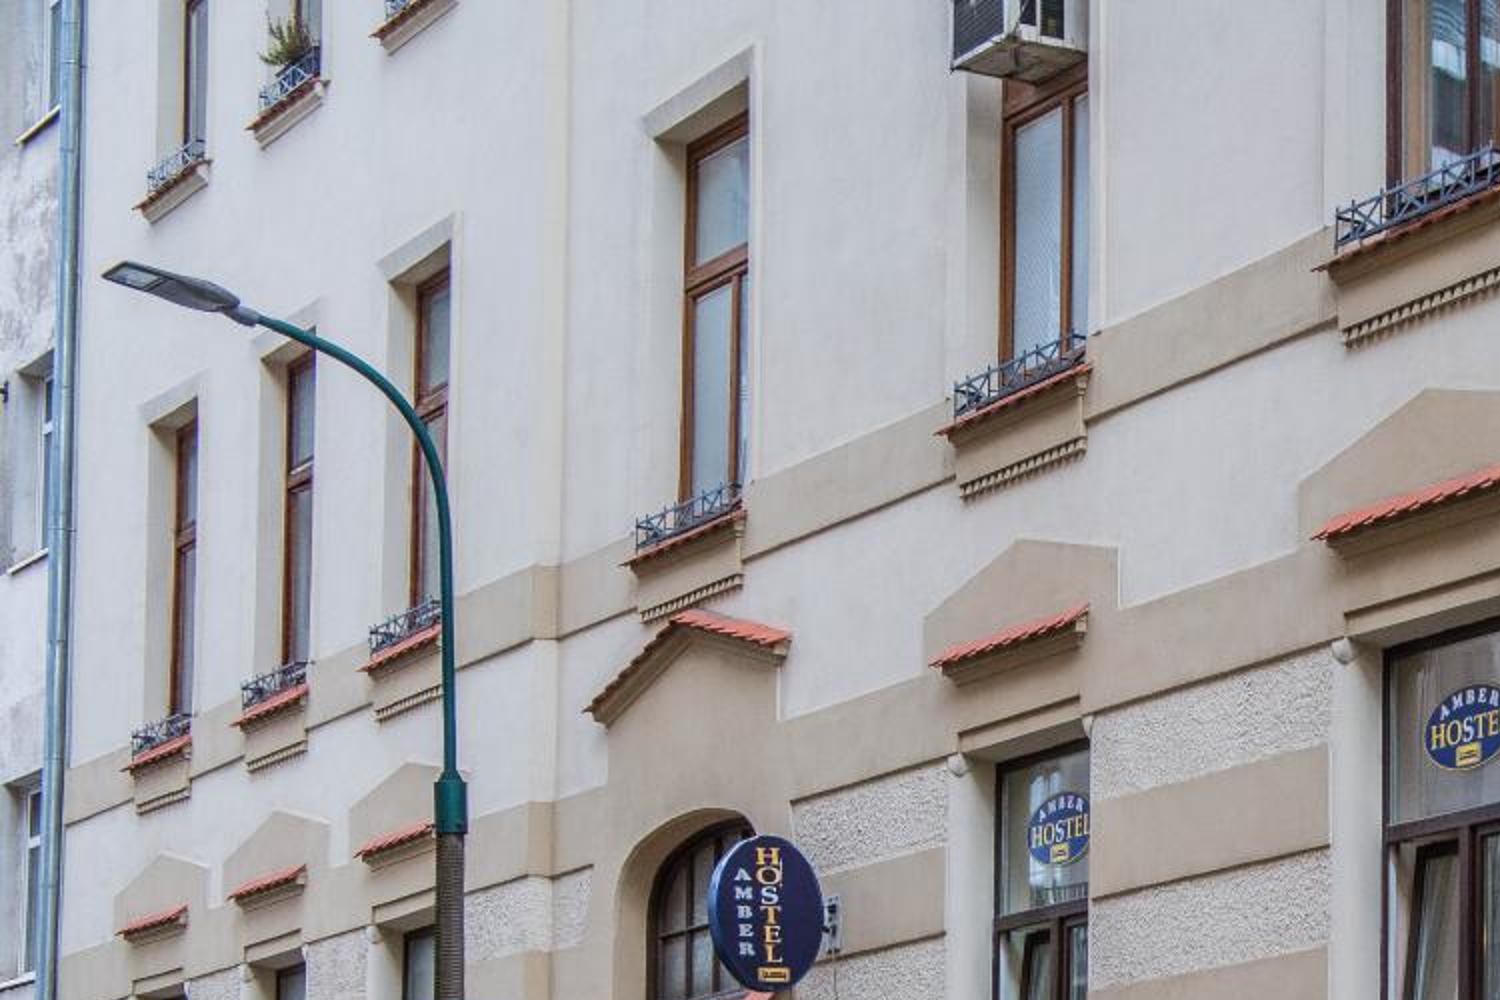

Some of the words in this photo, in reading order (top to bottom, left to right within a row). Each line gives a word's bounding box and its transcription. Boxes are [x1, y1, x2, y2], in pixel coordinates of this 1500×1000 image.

[1440, 687, 1500, 721] AMBER
[1031, 813, 1091, 849] HOSTEL
[734, 867, 756, 957] AMBER
[755, 847, 784, 963] HOSTEL
